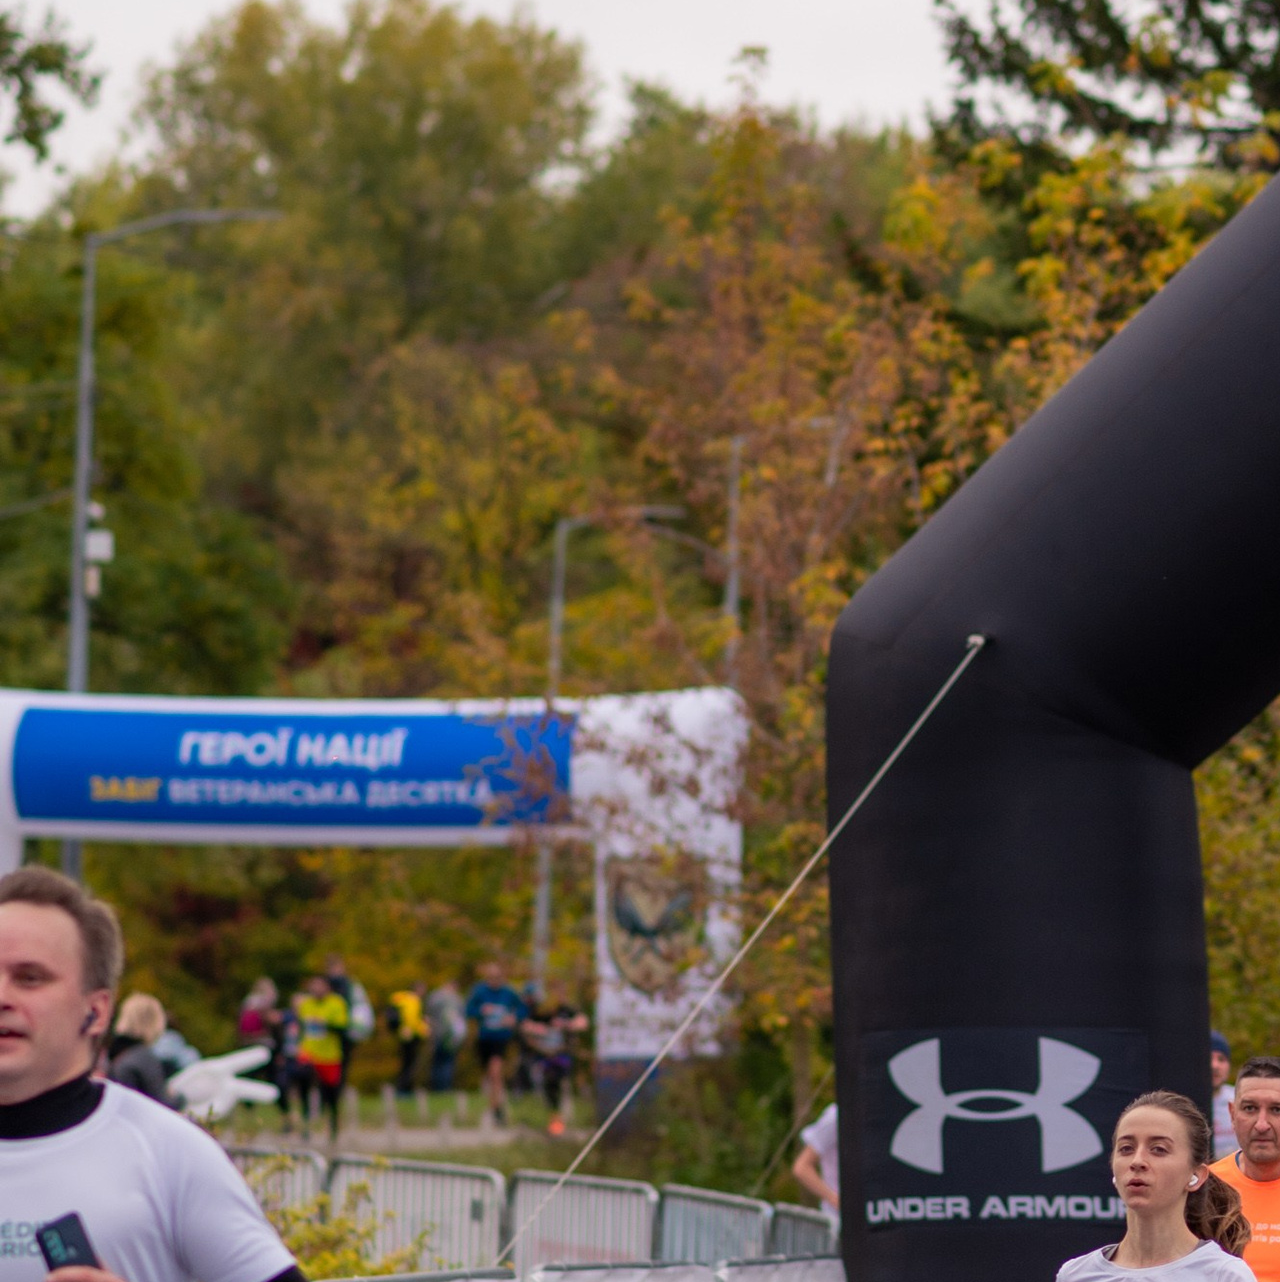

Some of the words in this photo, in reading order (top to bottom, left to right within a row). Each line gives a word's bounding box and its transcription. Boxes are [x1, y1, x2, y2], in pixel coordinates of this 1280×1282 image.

[178, 727, 293, 767] ГЕРОЇ
[295, 727, 409, 771] НАЦІЇ
[866, 1195, 971, 1223] UNDER
